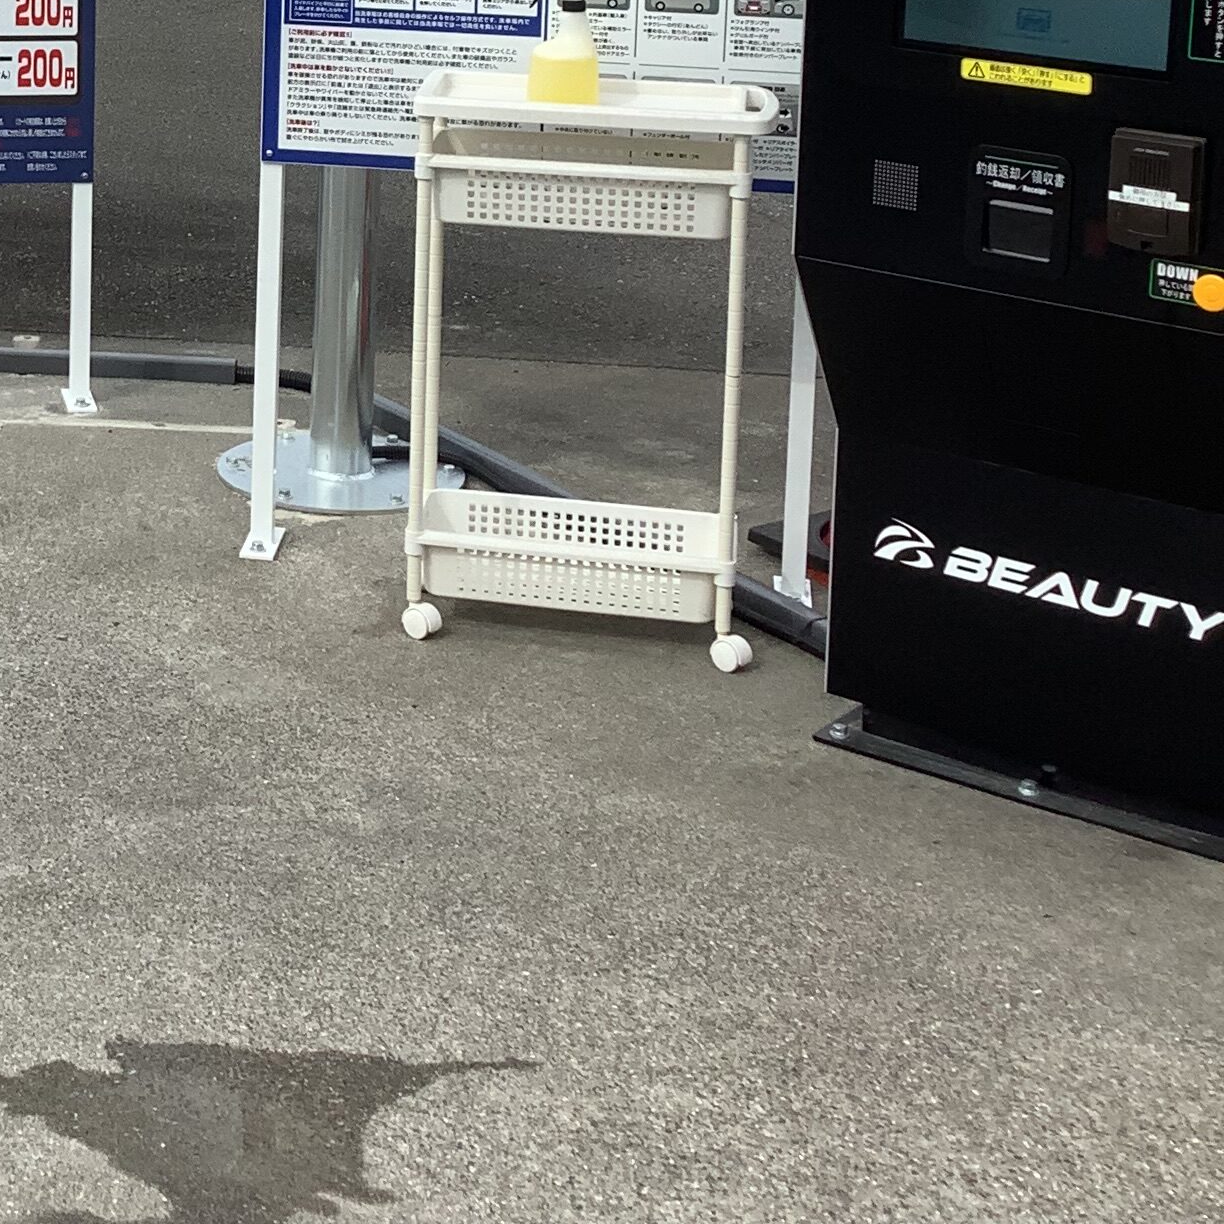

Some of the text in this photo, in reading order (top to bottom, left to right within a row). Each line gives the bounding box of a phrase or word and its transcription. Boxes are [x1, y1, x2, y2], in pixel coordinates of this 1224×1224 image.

[16, 48, 75, 89] 200円
[975, 160, 1066, 189] 釣銭返却／領収書
[1156, 262, 1200, 282] DOWN
[943, 545, 1224, 642] BEAUTY
